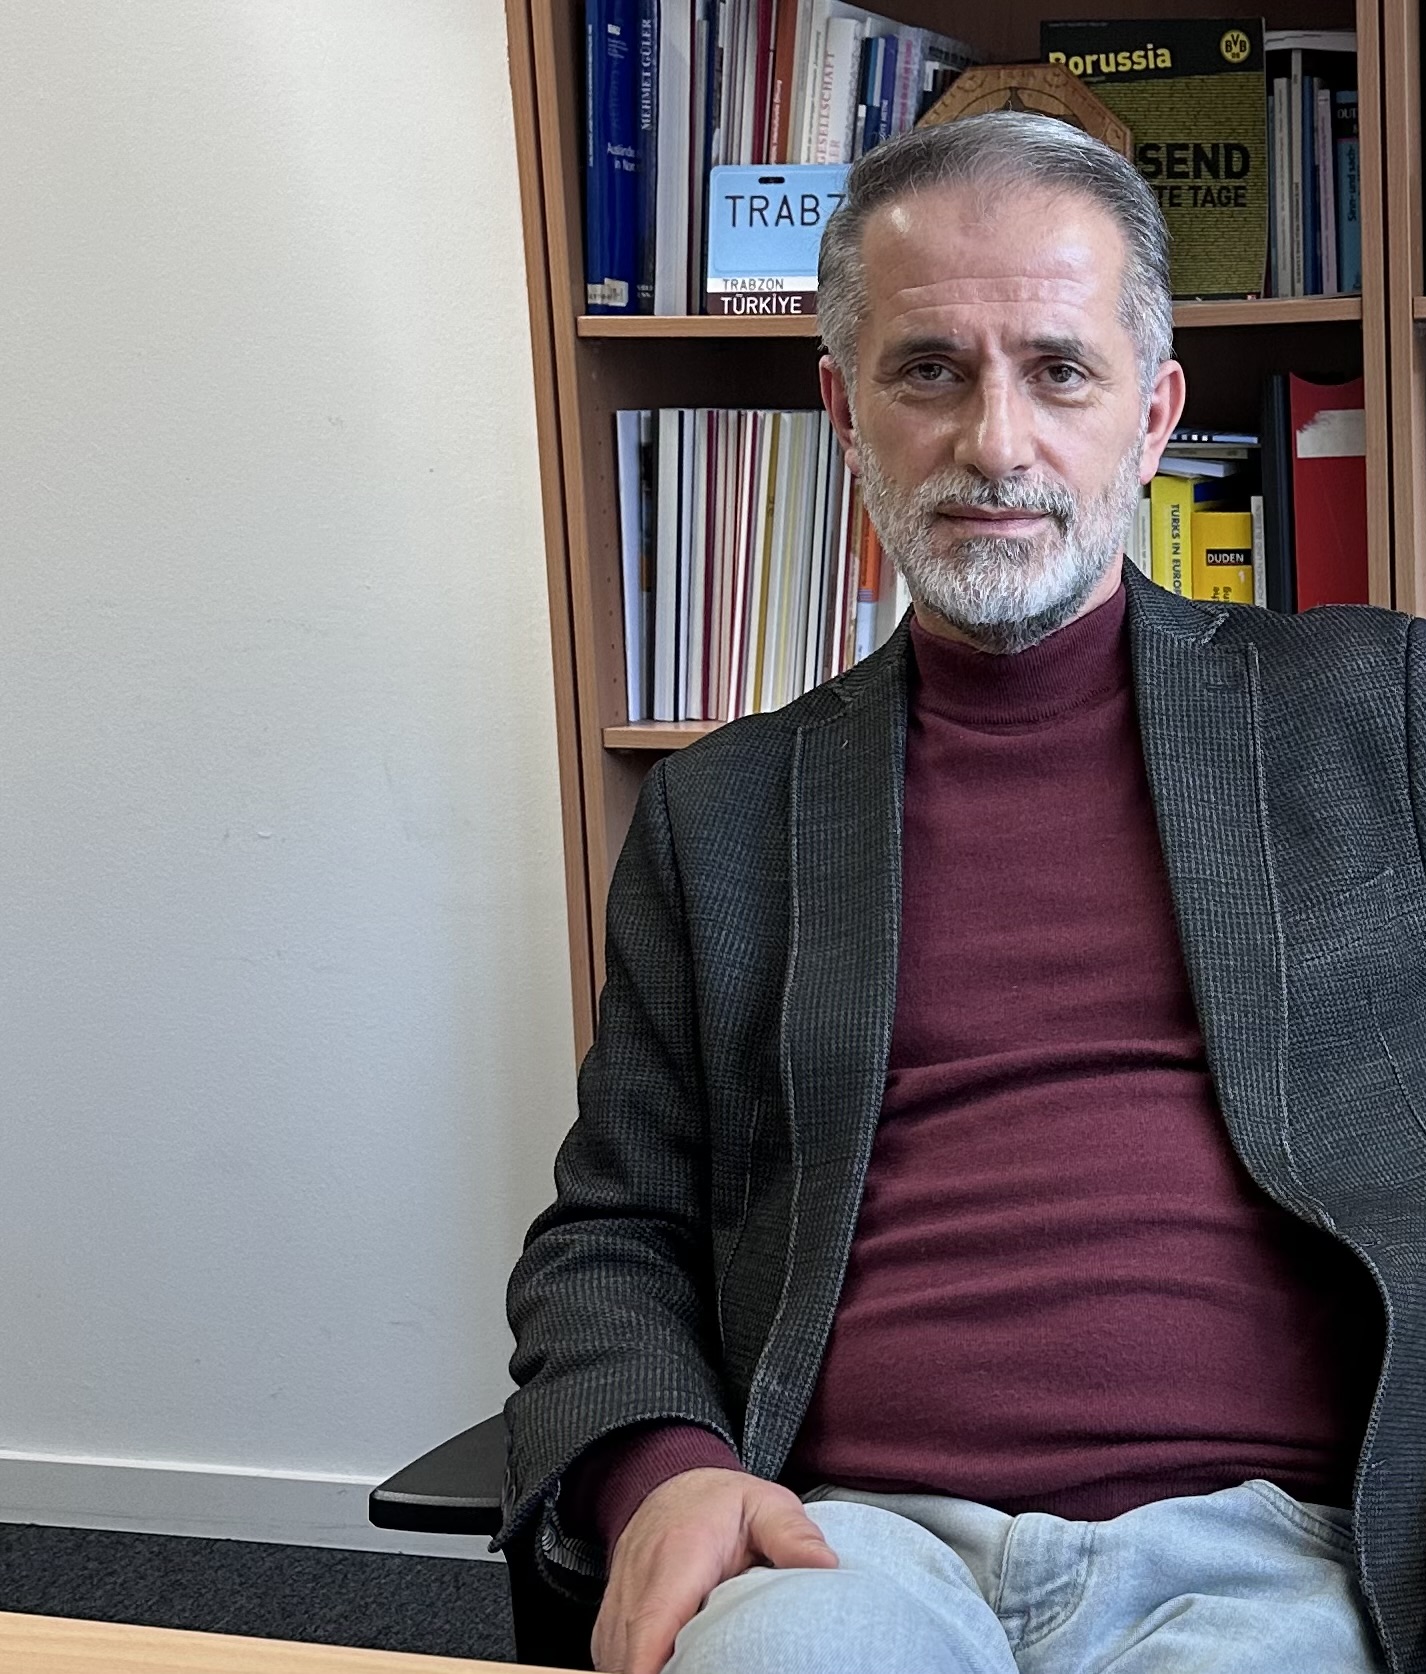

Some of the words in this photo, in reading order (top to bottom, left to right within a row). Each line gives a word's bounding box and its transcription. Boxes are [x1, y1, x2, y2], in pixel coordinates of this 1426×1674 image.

[1049, 43, 1172, 76] Borussia
[1188, 185, 1247, 207] TAGE
[722, 278, 784, 291] TRABZON
[720, 292, 802, 315] TÜRKİYE
[1170, 504, 1180, 540] TURKS
[1172, 542, 1181, 555] IN
[1207, 552, 1245, 564] DUDEN
